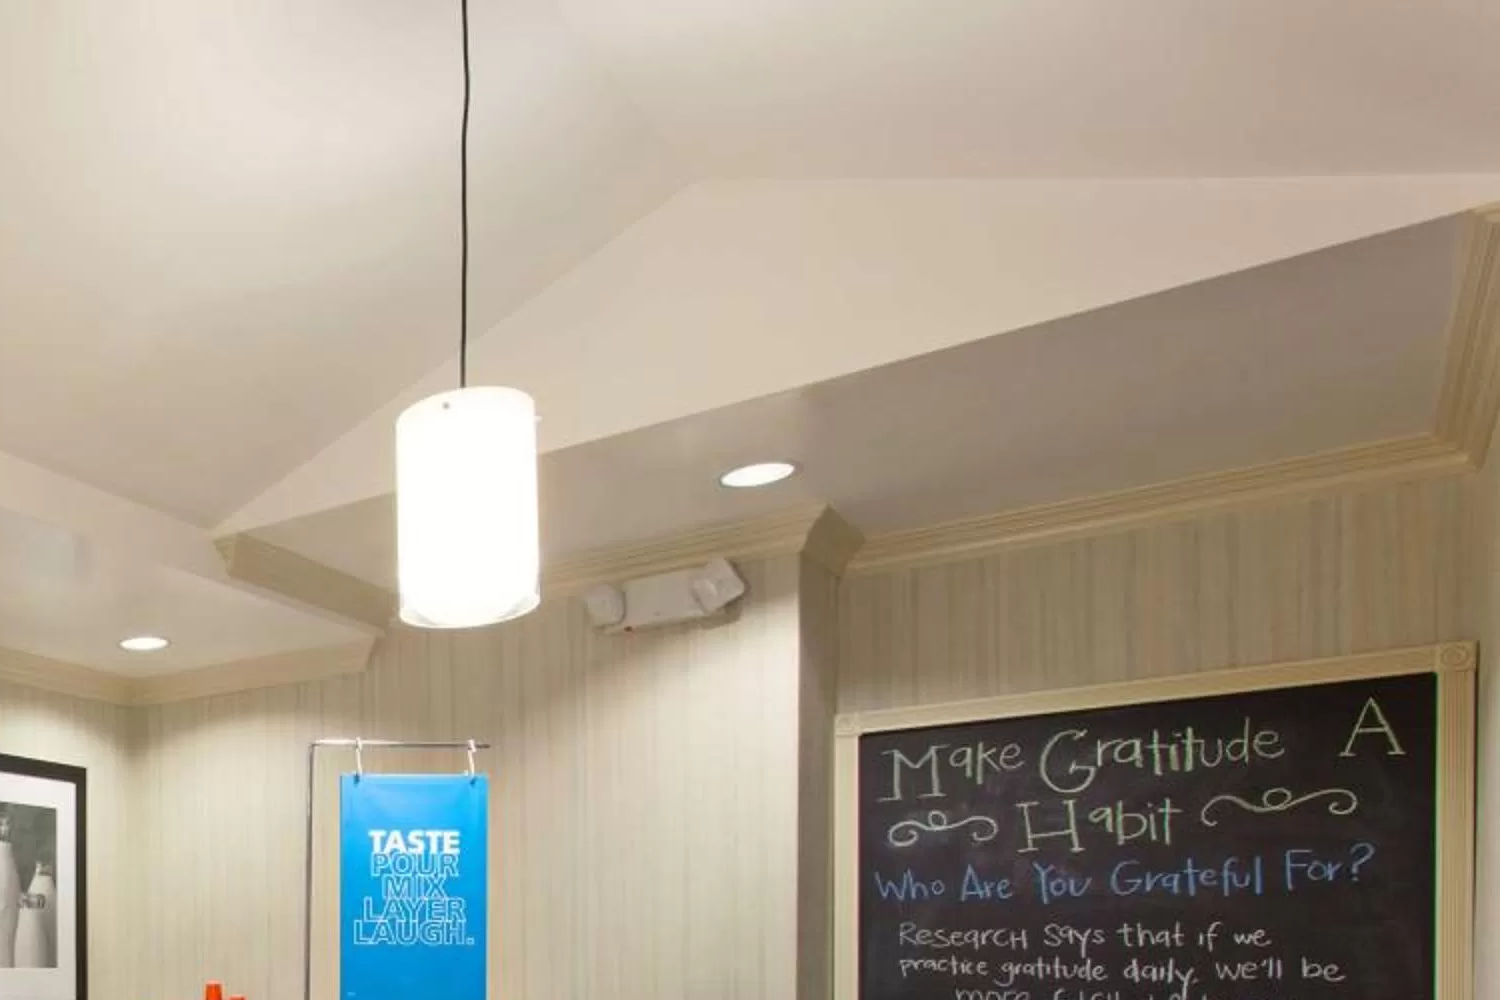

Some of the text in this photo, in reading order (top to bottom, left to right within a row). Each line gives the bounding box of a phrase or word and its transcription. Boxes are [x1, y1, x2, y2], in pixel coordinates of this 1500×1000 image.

[877, 697, 1406, 803] Make Gratitude A
[1015, 798, 1184, 853] Habit
[368, 829, 461, 855] TASTE
[371, 853, 460, 877] POUR
[874, 842, 1375, 904] Who Are You Grateful For?
[381, 874, 449, 900] MIX
[363, 897, 467, 922] LAYER
[353, 919, 476, 945] LAUGH.
[1116, 922, 1185, 949] that
[1199, 921, 1222, 952] if
[1233, 928, 1272, 947] we
[900, 955, 990, 978] practice
[992, 956, 1108, 987] gratitude
[1301, 956, 1346, 982] be
